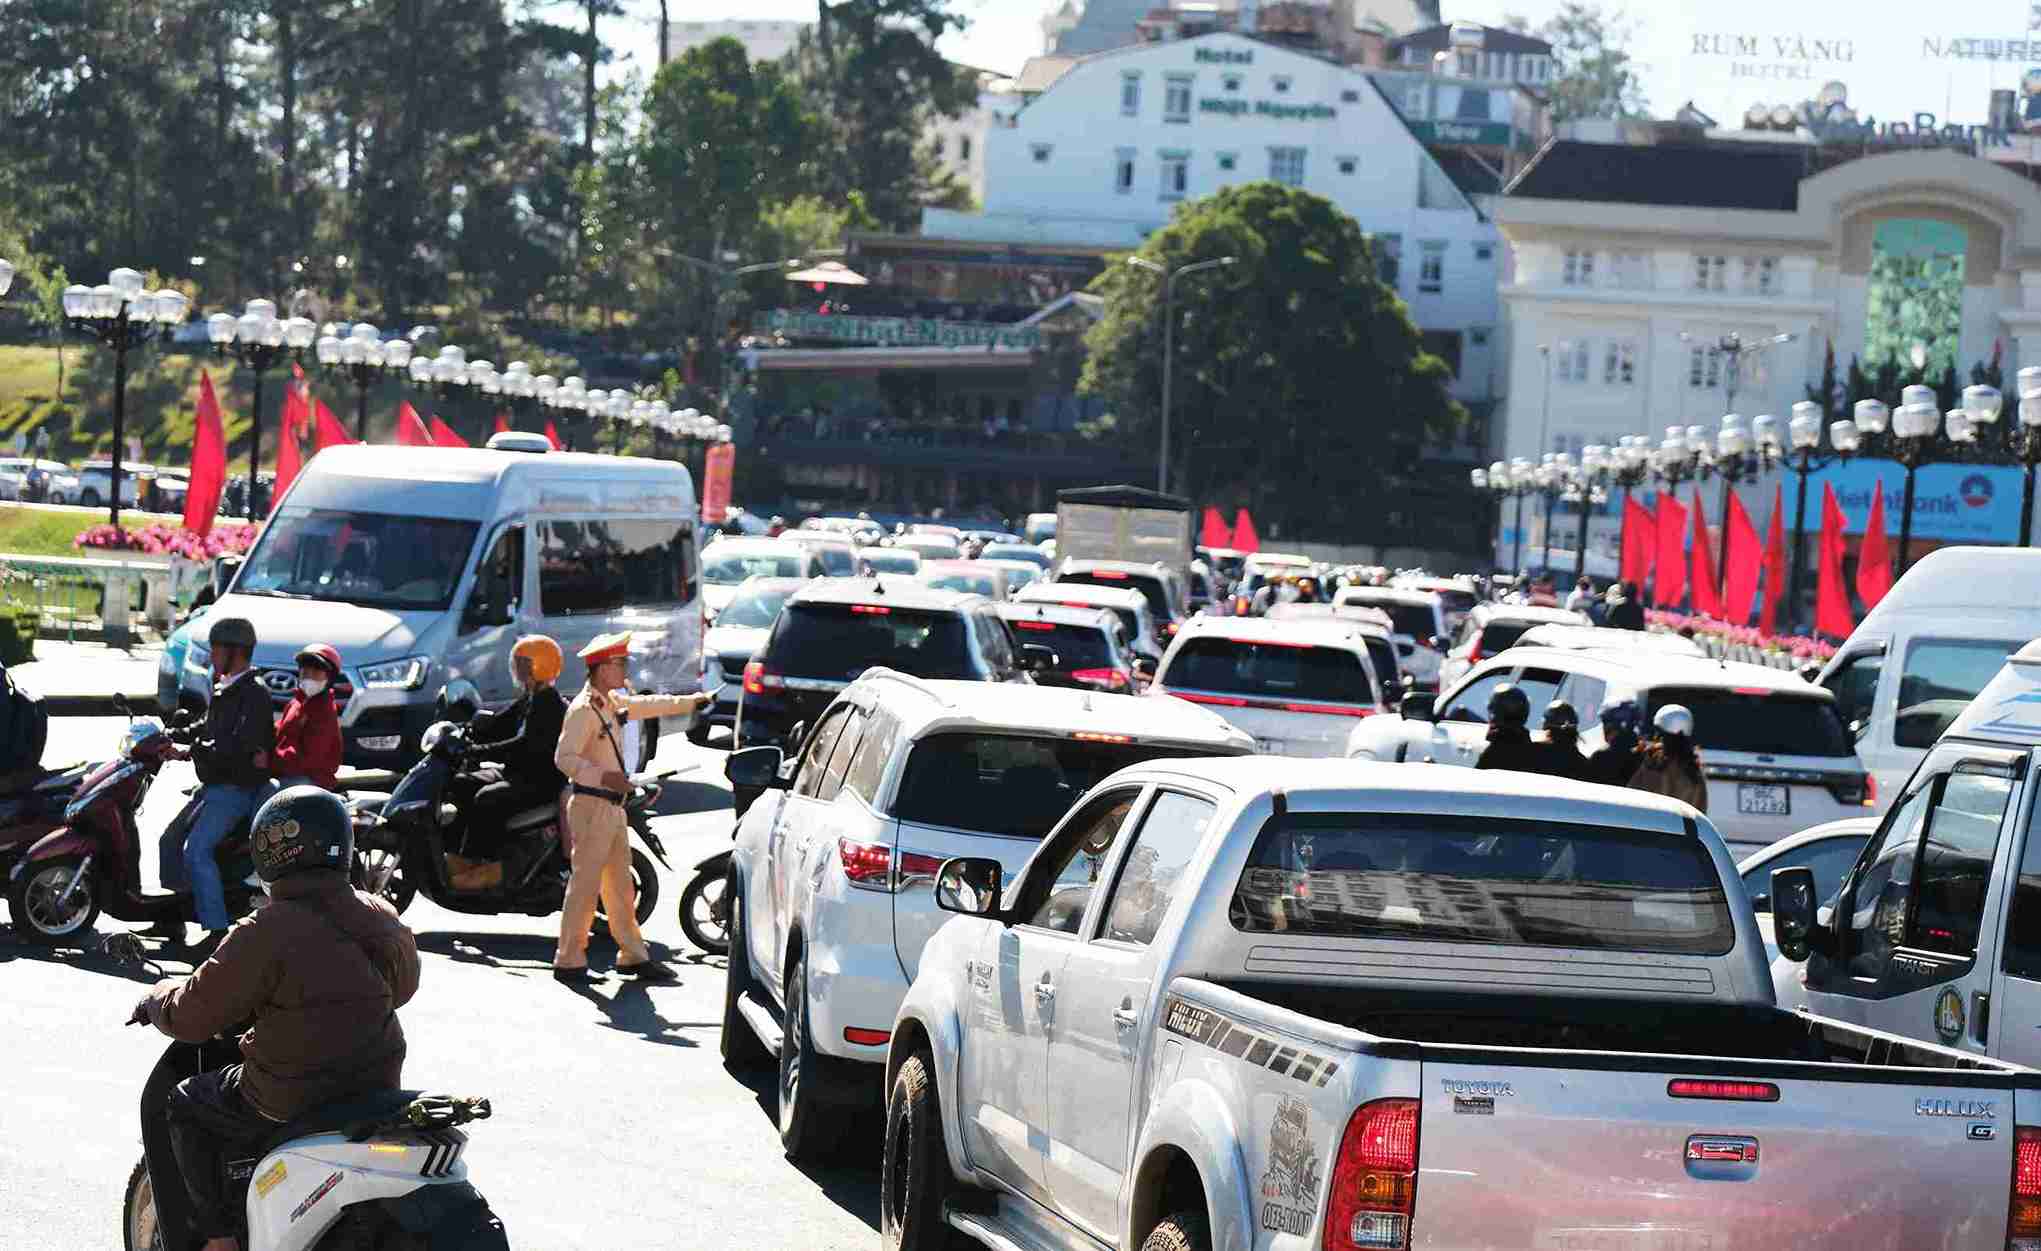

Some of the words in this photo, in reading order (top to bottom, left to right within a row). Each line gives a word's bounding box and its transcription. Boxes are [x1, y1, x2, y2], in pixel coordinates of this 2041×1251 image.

[1690, 32, 1759, 56] RUM
[1194, 48, 1253, 63] Hotel
[1441, 1079, 1514, 1097] TOYOTA
[1914, 1098, 1995, 1119] HILUX
